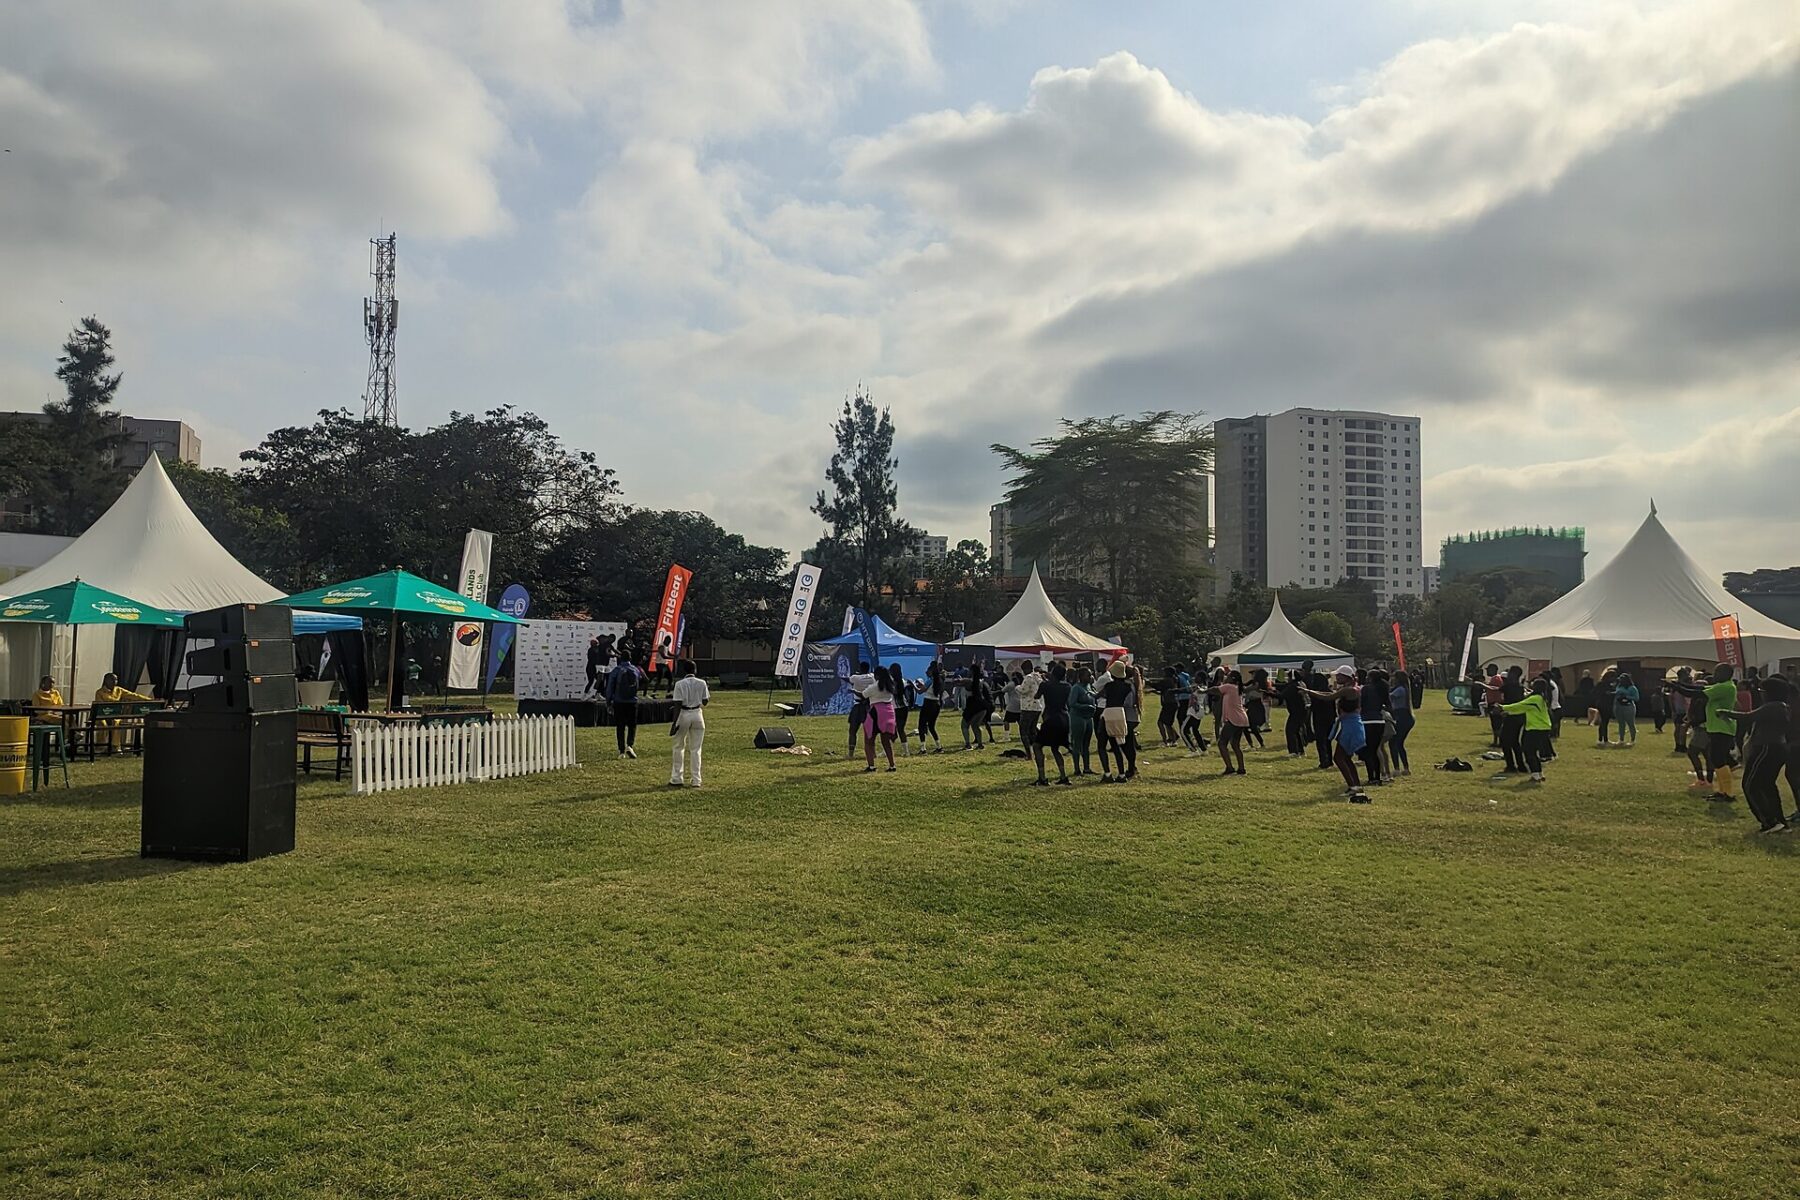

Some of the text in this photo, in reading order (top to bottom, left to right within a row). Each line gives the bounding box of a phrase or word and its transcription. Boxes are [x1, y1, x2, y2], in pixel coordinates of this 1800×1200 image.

[467, 569, 476, 599] LANDS
[476, 574, 484, 590] Club
[663, 574, 683, 626] FitBeat
